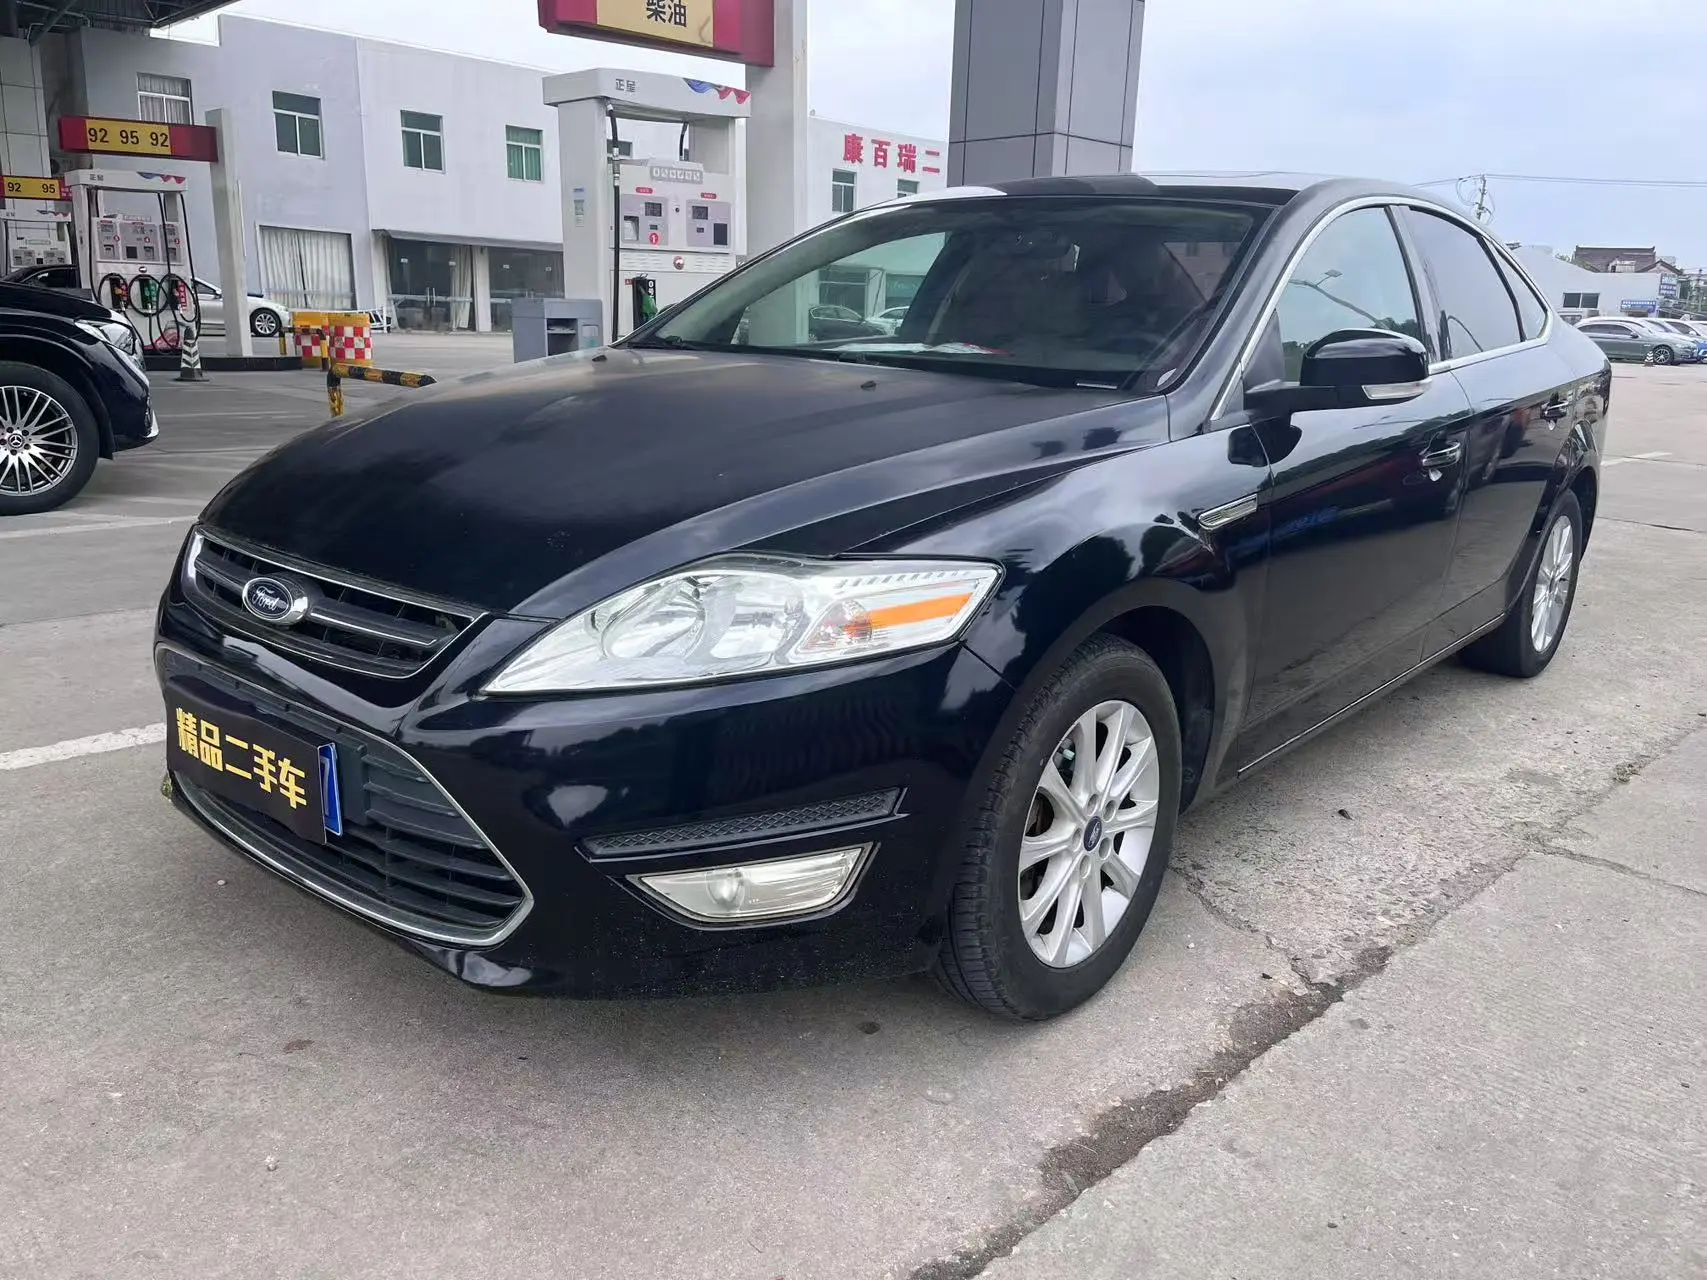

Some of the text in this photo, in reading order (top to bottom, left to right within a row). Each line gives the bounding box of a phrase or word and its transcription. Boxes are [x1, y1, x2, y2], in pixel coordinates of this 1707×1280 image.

[646, 0, 687, 27] 柴油
[88, 127, 169, 147] 92 95 92
[843, 133, 940, 173] 康百瑞二
[7, 182, 22, 192] 92
[42, 183, 56, 193] 95
[252, 586, 280, 611] Ford
[176, 707, 307, 809] 精品二手车
